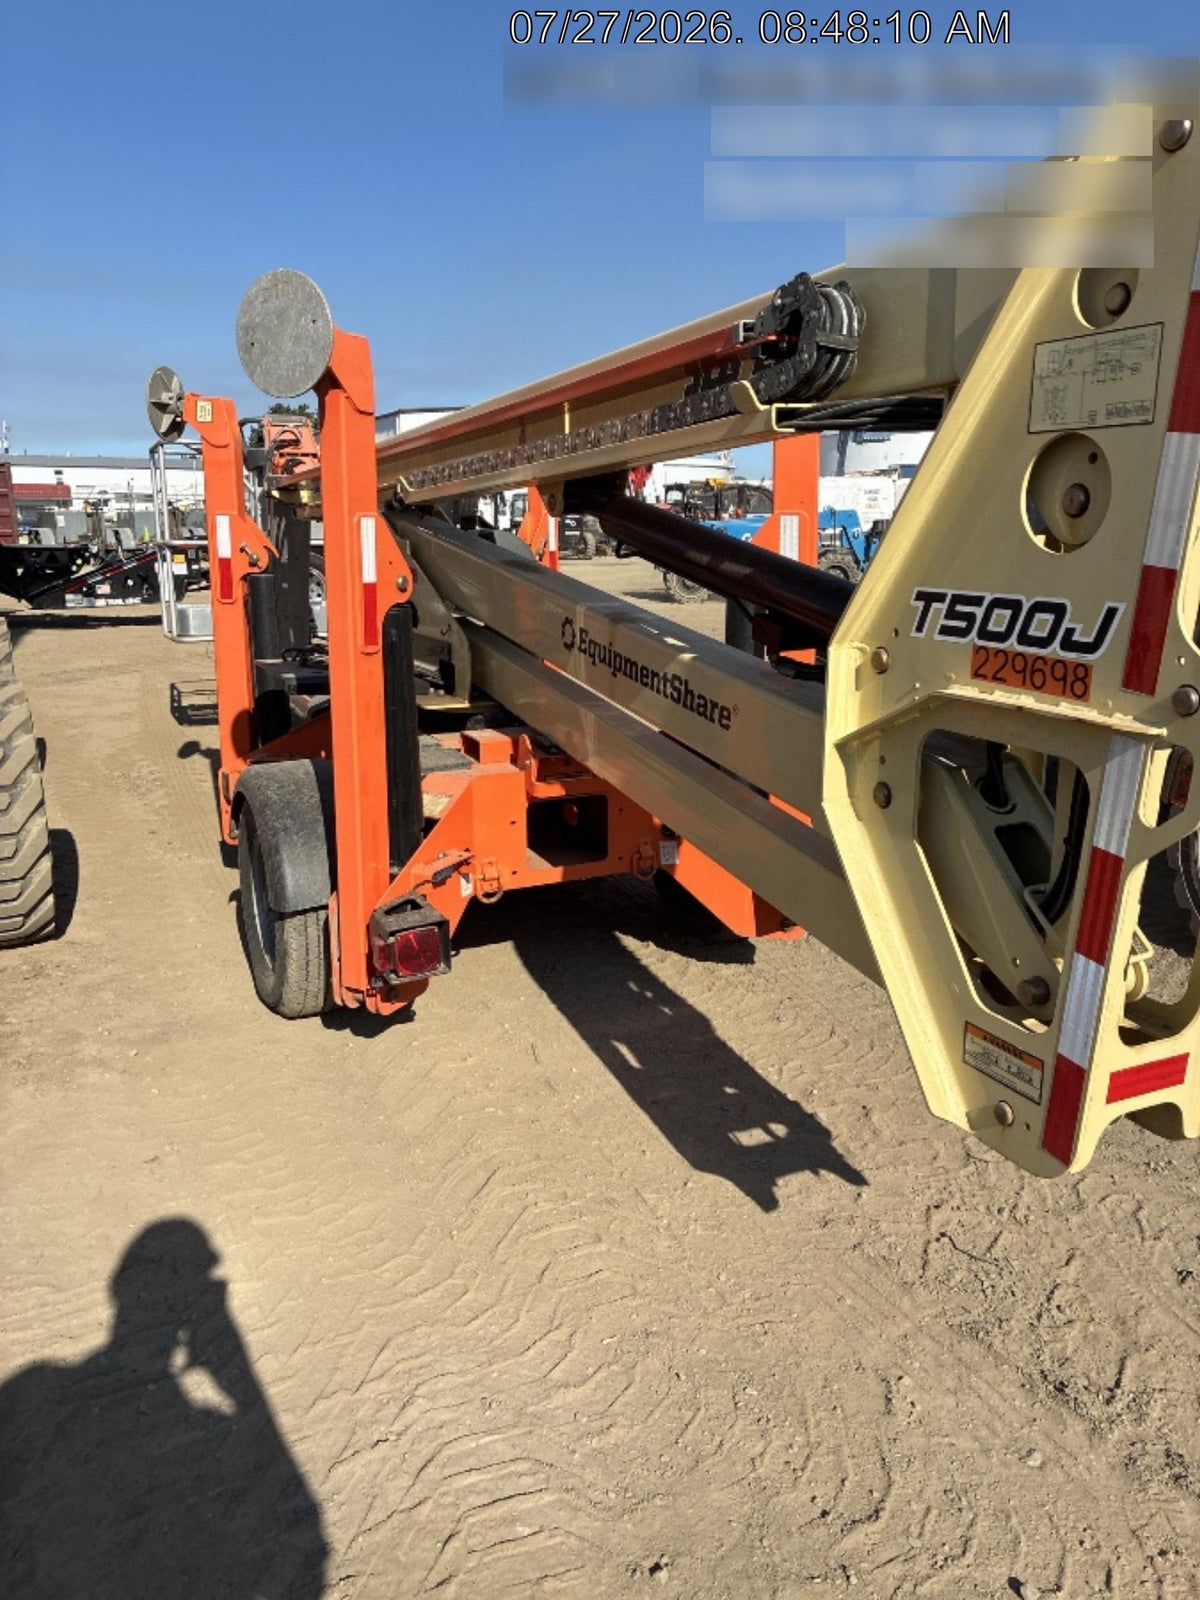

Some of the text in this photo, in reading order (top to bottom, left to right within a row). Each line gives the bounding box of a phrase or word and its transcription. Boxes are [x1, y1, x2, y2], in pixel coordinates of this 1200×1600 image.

[911, 588, 1123, 657] T500J
[577, 626, 732, 731] EquipmentShare
[972, 645, 1091, 701] 229698
